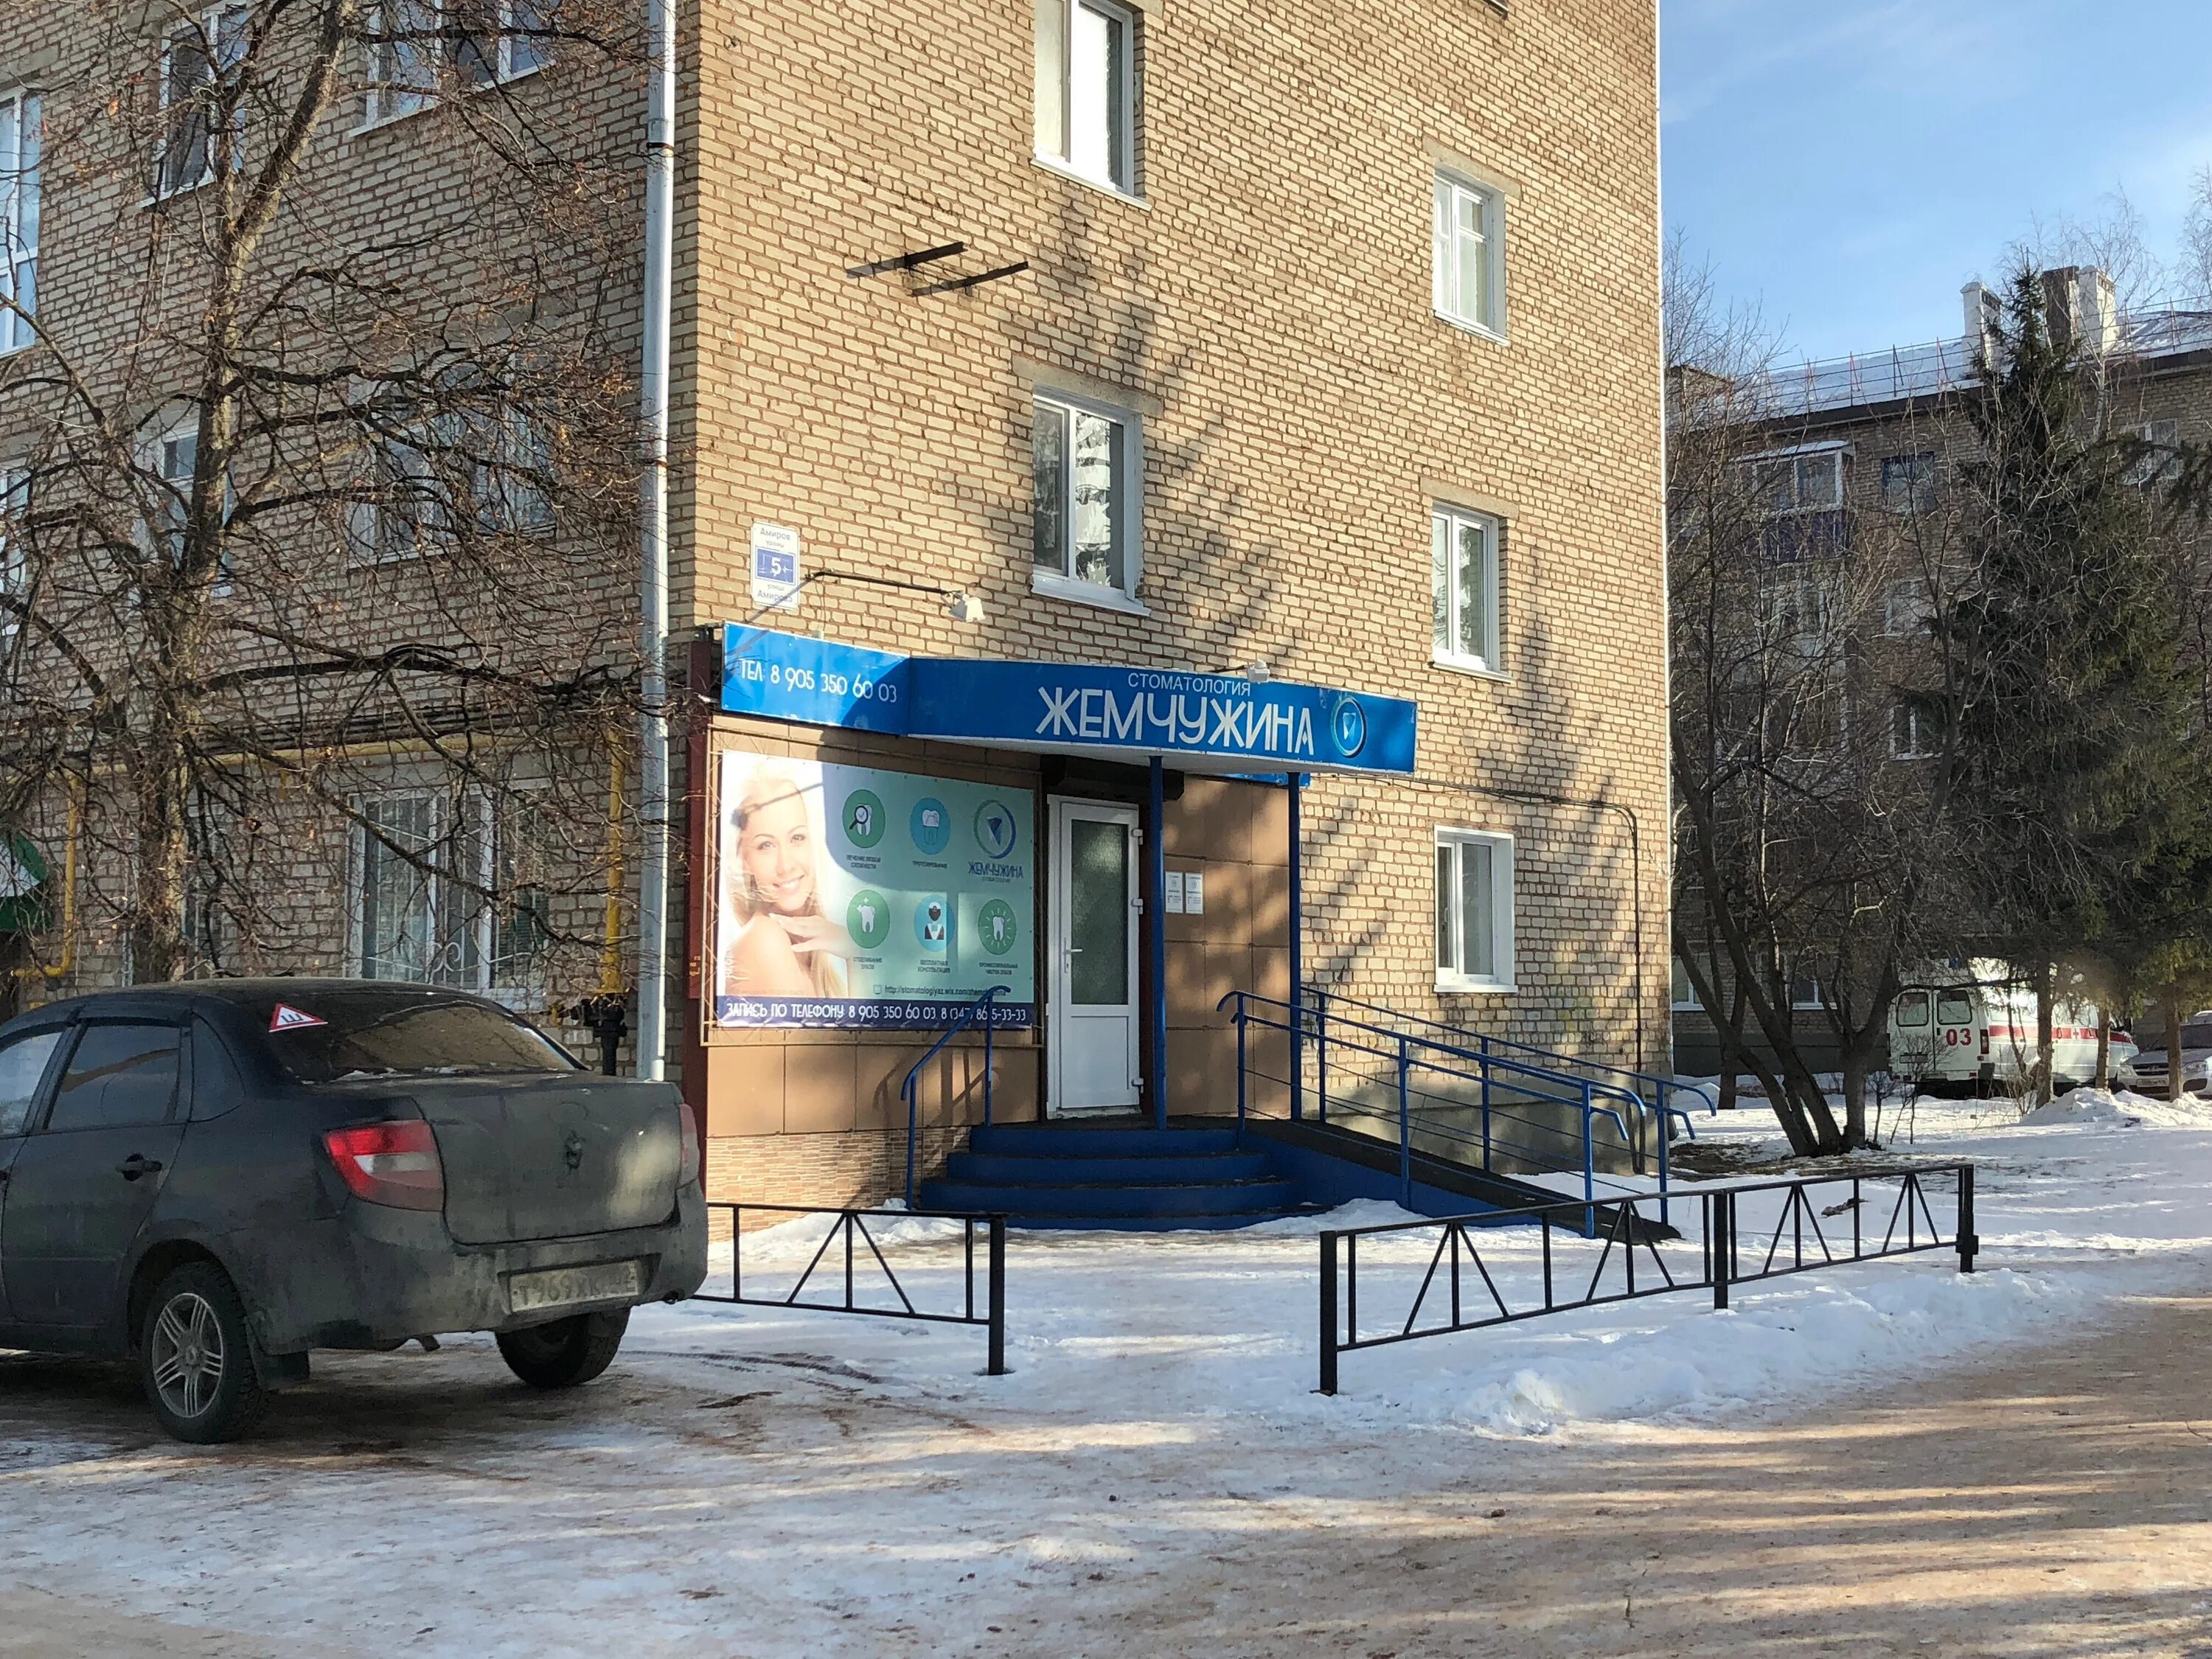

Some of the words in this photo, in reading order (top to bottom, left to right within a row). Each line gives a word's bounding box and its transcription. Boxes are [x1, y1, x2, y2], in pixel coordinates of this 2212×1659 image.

[760, 527, 790, 540] Амиров
[771, 557, 782, 577] 5
[770, 664, 781, 684] 8
[785, 667, 815, 692] 905
[820, 672, 848, 695] 350
[852, 673, 873, 699] 60
[878, 683, 897, 703] 03
[1127, 672, 1251, 697] СТОМАТОЛОГИЯ
[1035, 686, 1314, 755] ЖЕМЧУЖИНА
[968, 861, 1023, 879] ЖЕМЧУЖИНА
[281, 1013, 304, 1023] Ш
[726, 1003, 768, 1018] ЗАПИСЬ
[771, 1004, 787, 1018] ПО
[849, 1005, 855, 1018] 8
[858, 1005, 879, 1021] 905
[883, 1006, 902, 1019] 350
[905, 1004, 919, 1019] 60
[941, 1007, 947, 1020] 8
[992, 1008, 1026, 1021] 5-33-33
[1945, 1028, 1972, 1046] 03
